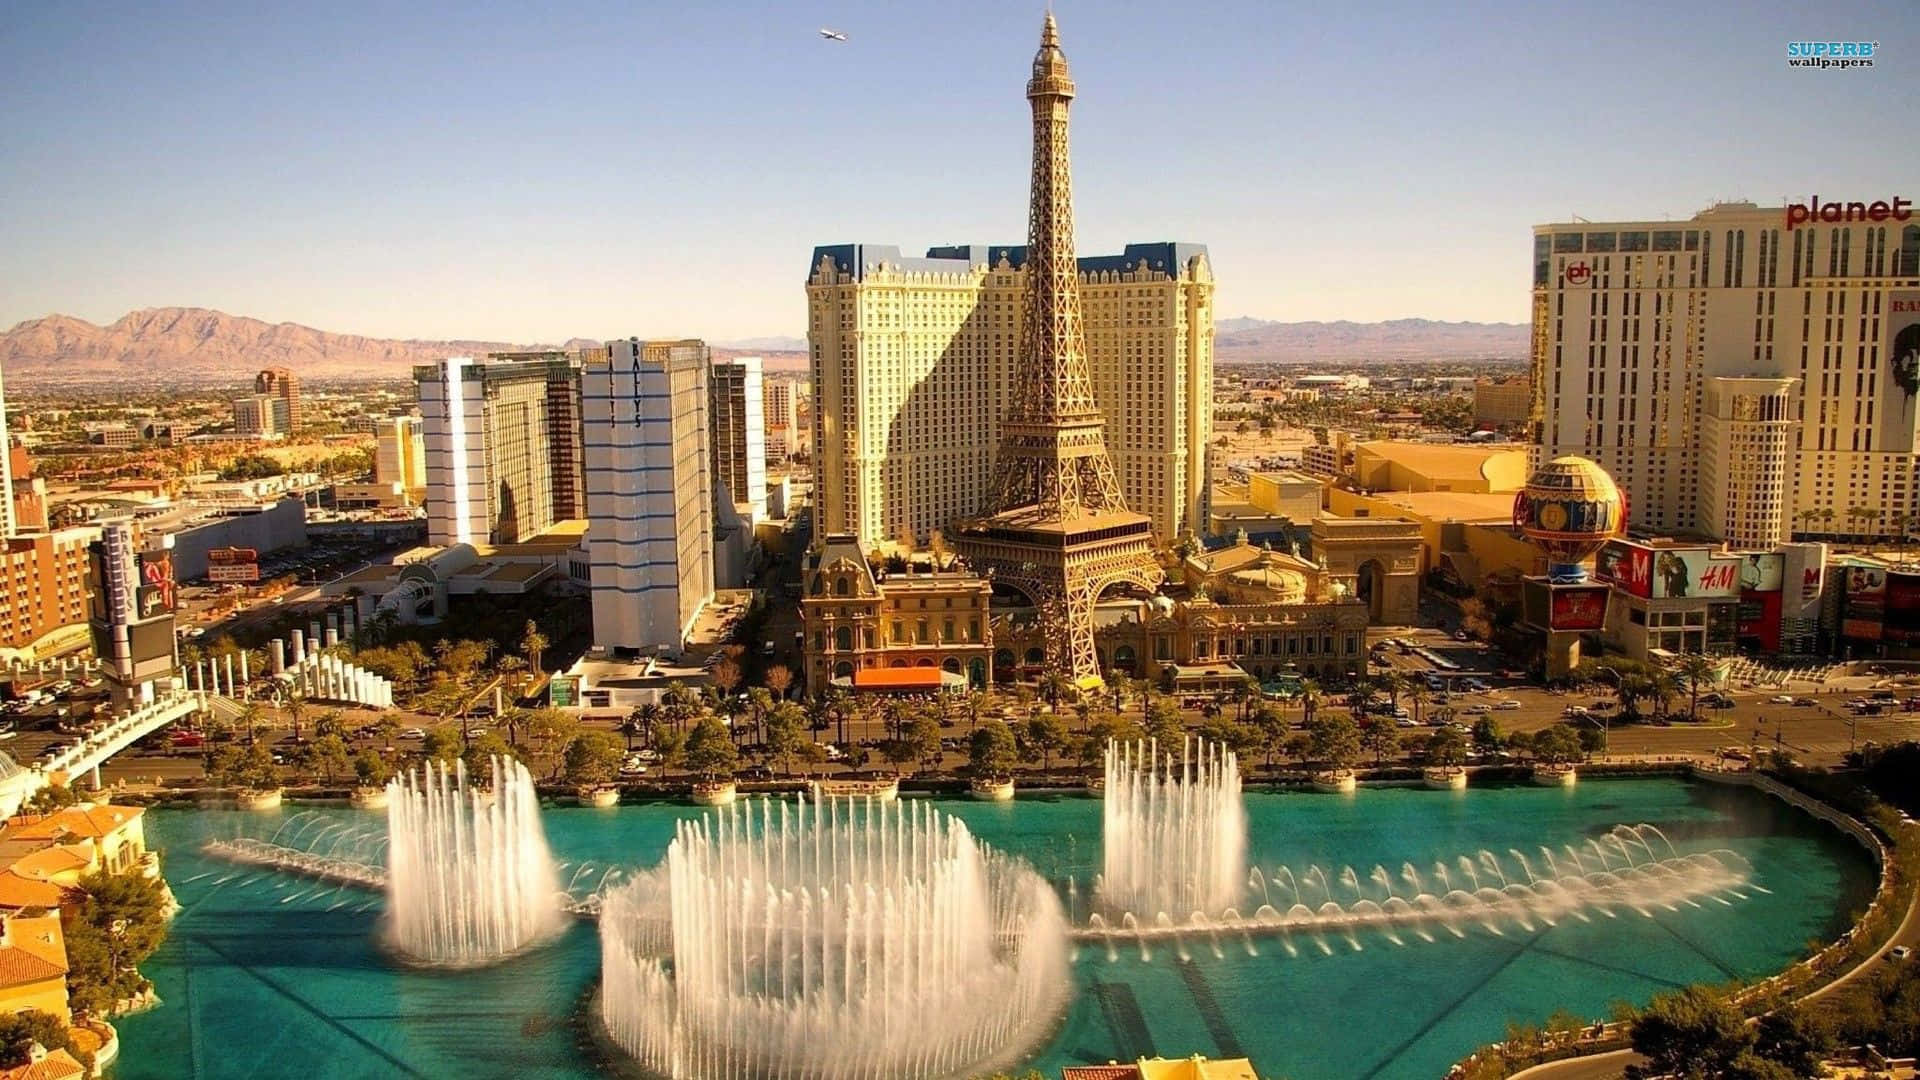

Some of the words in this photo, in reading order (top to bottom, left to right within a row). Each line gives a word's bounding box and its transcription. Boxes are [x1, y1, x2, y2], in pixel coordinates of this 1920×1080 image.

[1786, 195, 1912, 231] planet
[1567, 261, 1591, 282] ph
[1892, 300, 1920, 313] RA
[632, 343, 641, 428] BALLYS
[1699, 564, 1737, 590] H&M
